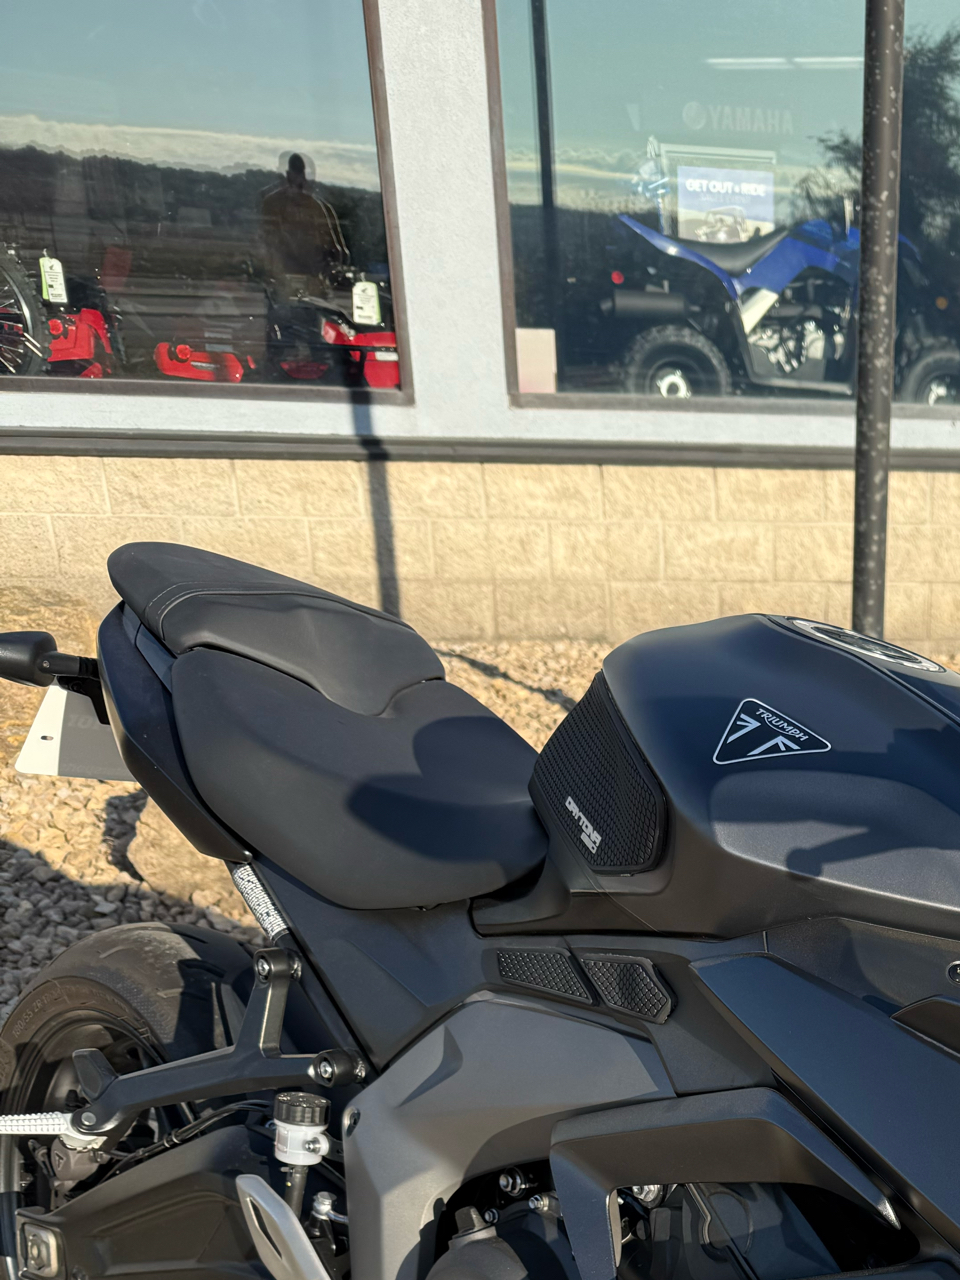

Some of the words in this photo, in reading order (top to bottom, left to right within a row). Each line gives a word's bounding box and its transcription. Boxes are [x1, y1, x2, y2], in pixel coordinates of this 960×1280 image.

[708, 105, 793, 134] YAMAHA
[685, 179, 708, 192] GET
[708, 180, 734, 194] OUT
[740, 183, 767, 197] RIDE
[756, 708, 809, 741] TRIUMPH
